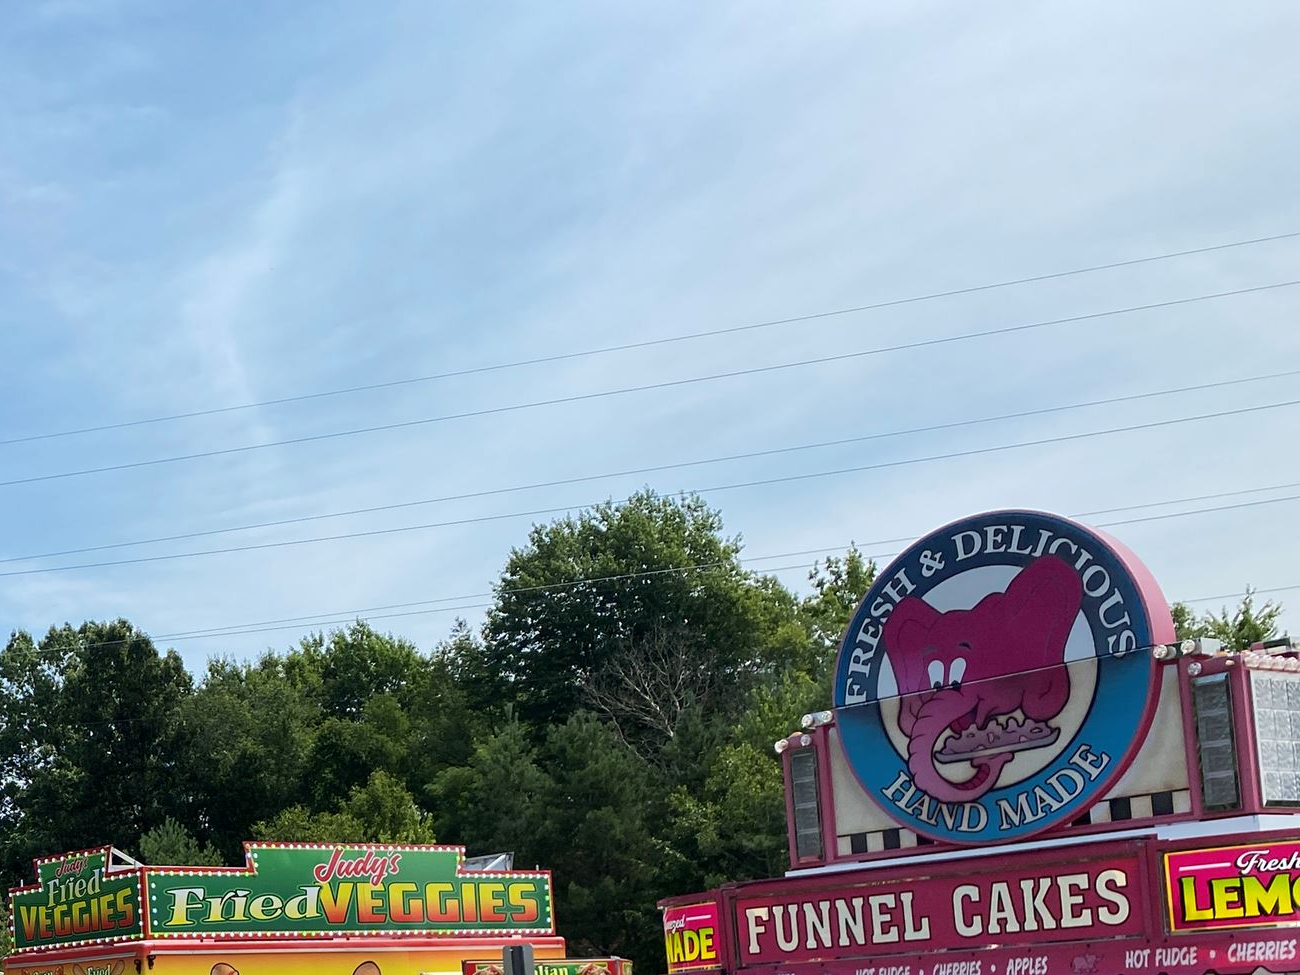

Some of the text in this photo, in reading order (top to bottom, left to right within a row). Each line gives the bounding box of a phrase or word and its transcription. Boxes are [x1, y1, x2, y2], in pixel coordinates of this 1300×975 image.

[844, 524, 1138, 706] FRESH & DELICIOUS
[880, 743, 1112, 834] HAND MADE
[47, 868, 101, 907] Fried
[55, 857, 89, 878] Judy's
[314, 847, 402, 887] Judy's
[19, 887, 134, 942] VEGGIES
[164, 882, 541, 926] Fried VEGGIES
[745, 868, 1132, 955] FUNNEL CAKES
[1125, 939, 1297, 968] HOT FUDGE CHERRIES
